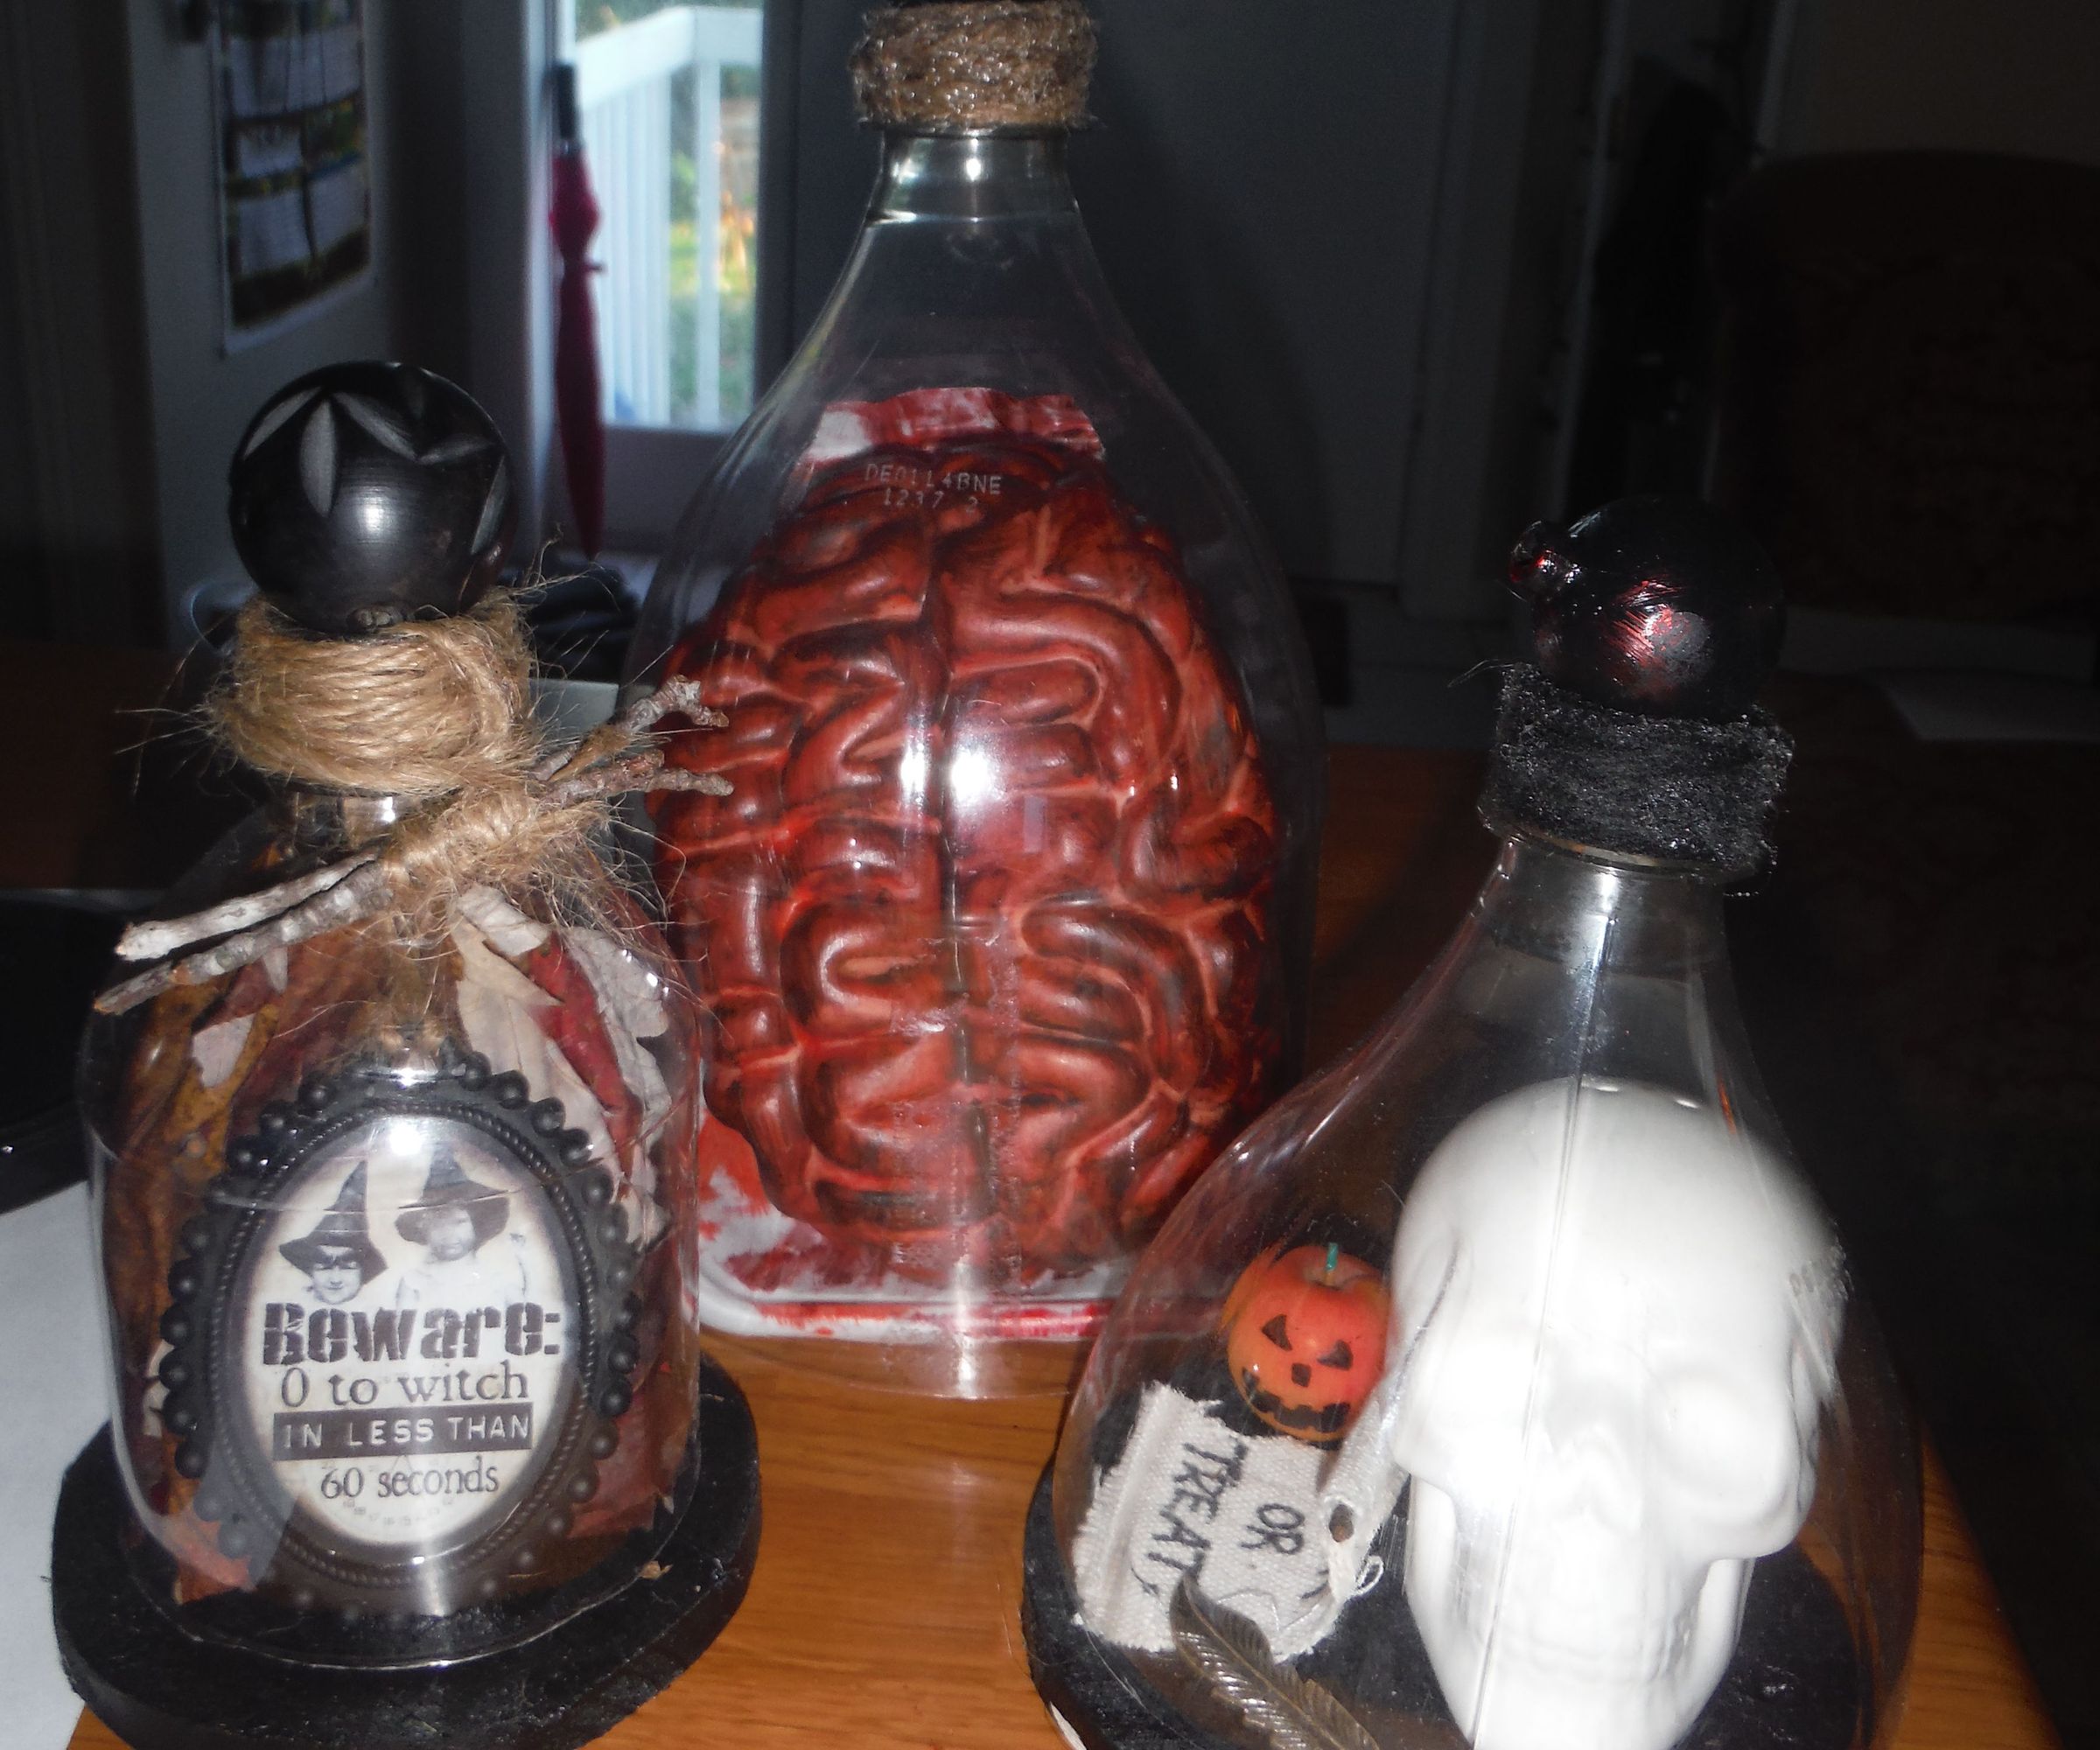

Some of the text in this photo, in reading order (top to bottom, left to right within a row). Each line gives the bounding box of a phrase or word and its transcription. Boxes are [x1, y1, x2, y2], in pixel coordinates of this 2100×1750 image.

[262, 1300, 561, 1366] Beware:
[280, 1359, 530, 1408] 0 to witch
[283, 1414, 529, 1449] IN LESS THAN
[320, 1455, 500, 1500] 60 seconds
